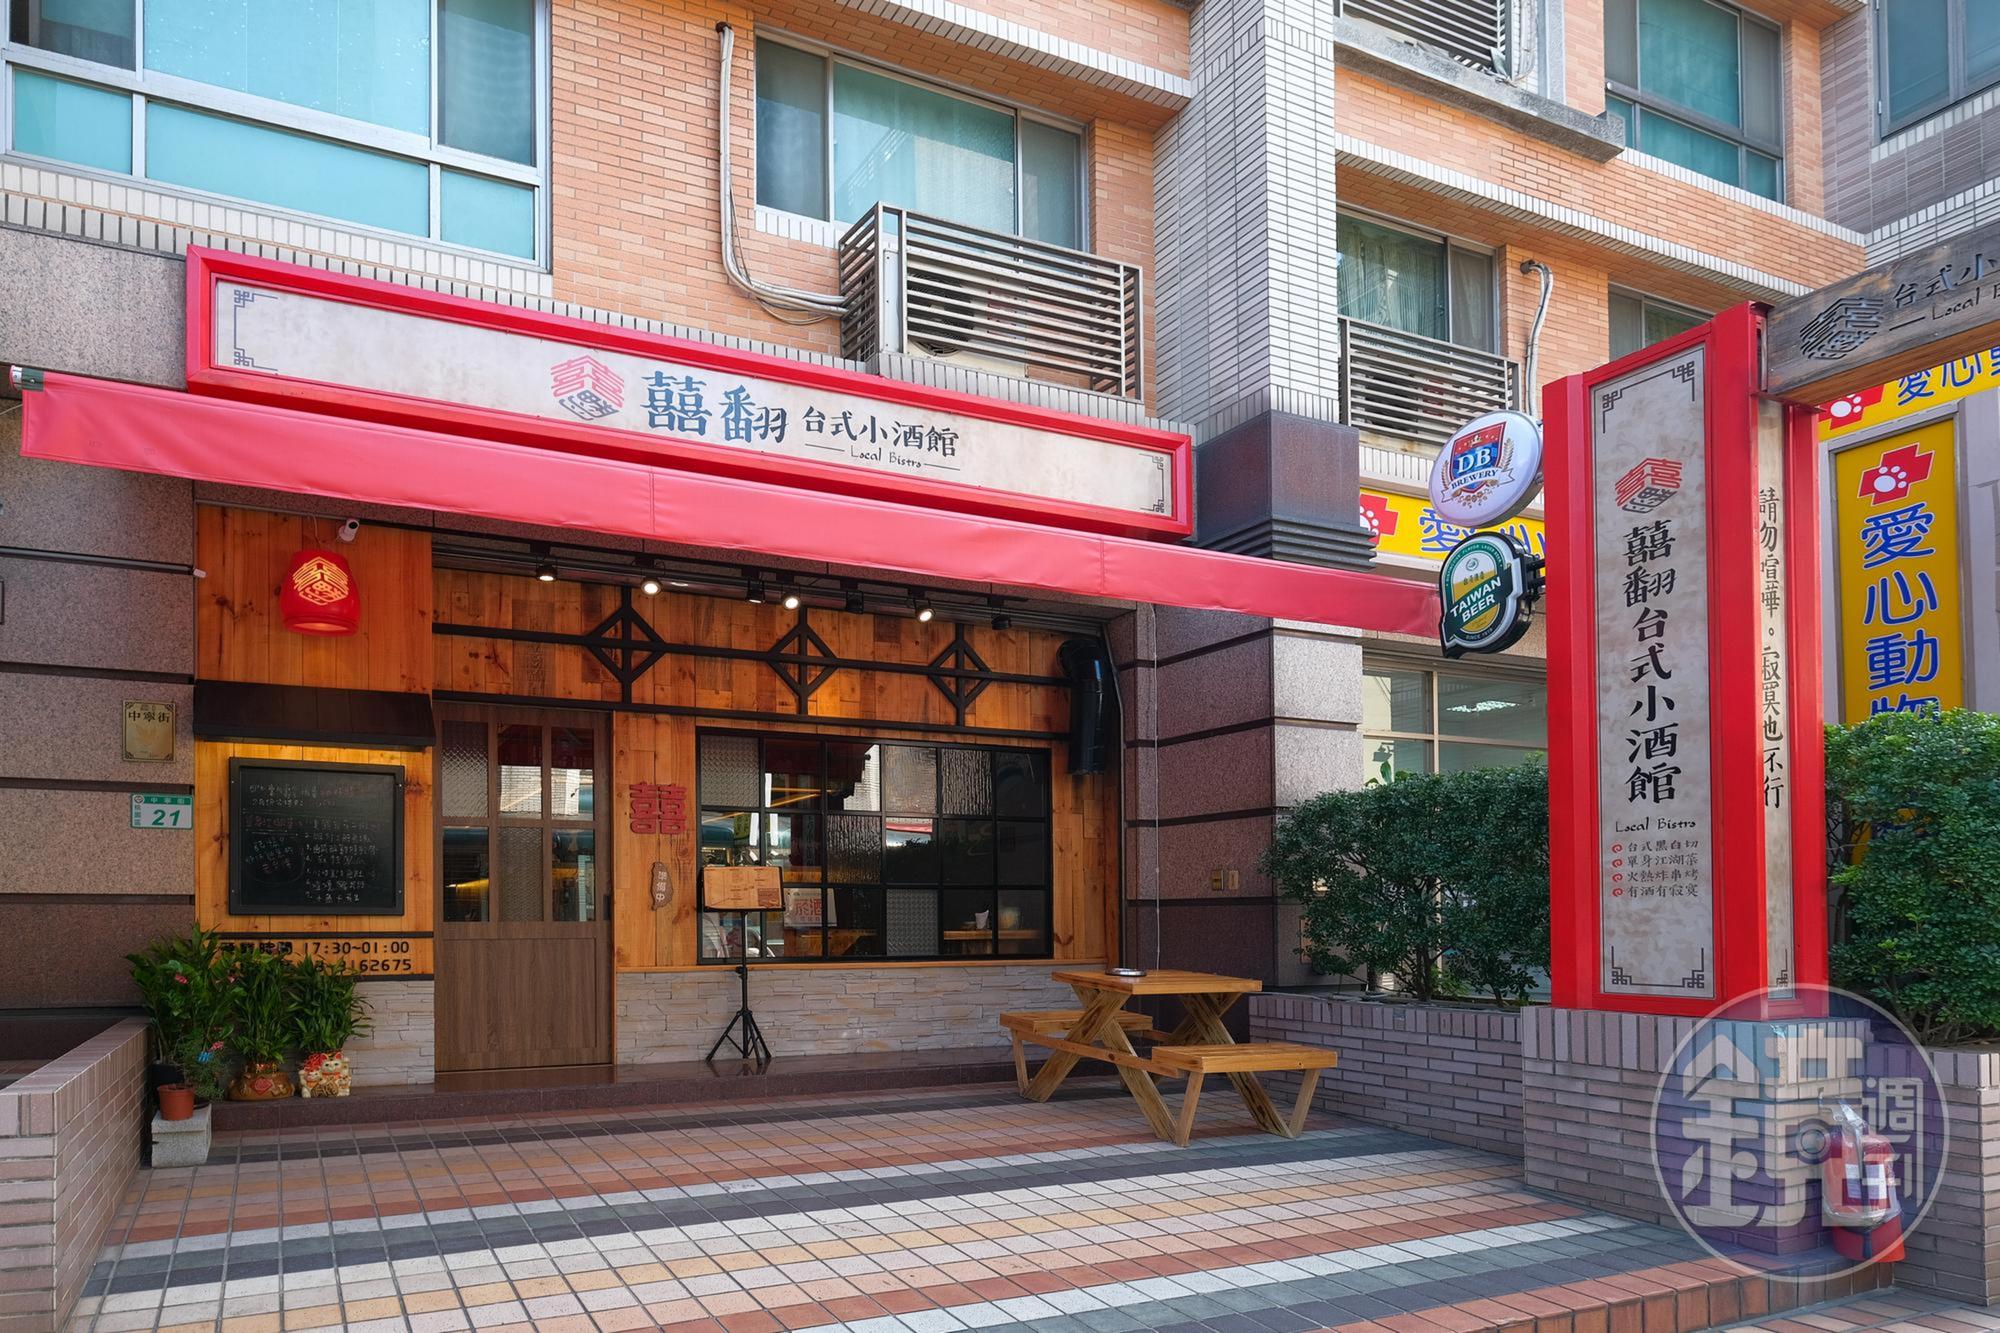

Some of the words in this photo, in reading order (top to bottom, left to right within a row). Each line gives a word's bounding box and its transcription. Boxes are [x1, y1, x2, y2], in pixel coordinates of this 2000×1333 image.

[1931, 286, 1980, 321] Local
[803, 406, 960, 457] 台式小酒館
[850, 445, 882, 461] Local
[889, 451, 922, 468] Bistro
[1457, 447, 1492, 474] DB
[1451, 469, 1498, 489] BREWERY
[1450, 576, 1502, 617] TAIWAN
[1462, 593, 1496, 622] BEER
[152, 809, 180, 826] 21
[1616, 816, 1649, 832] Local
[1657, 817, 1696, 831] Bistro
